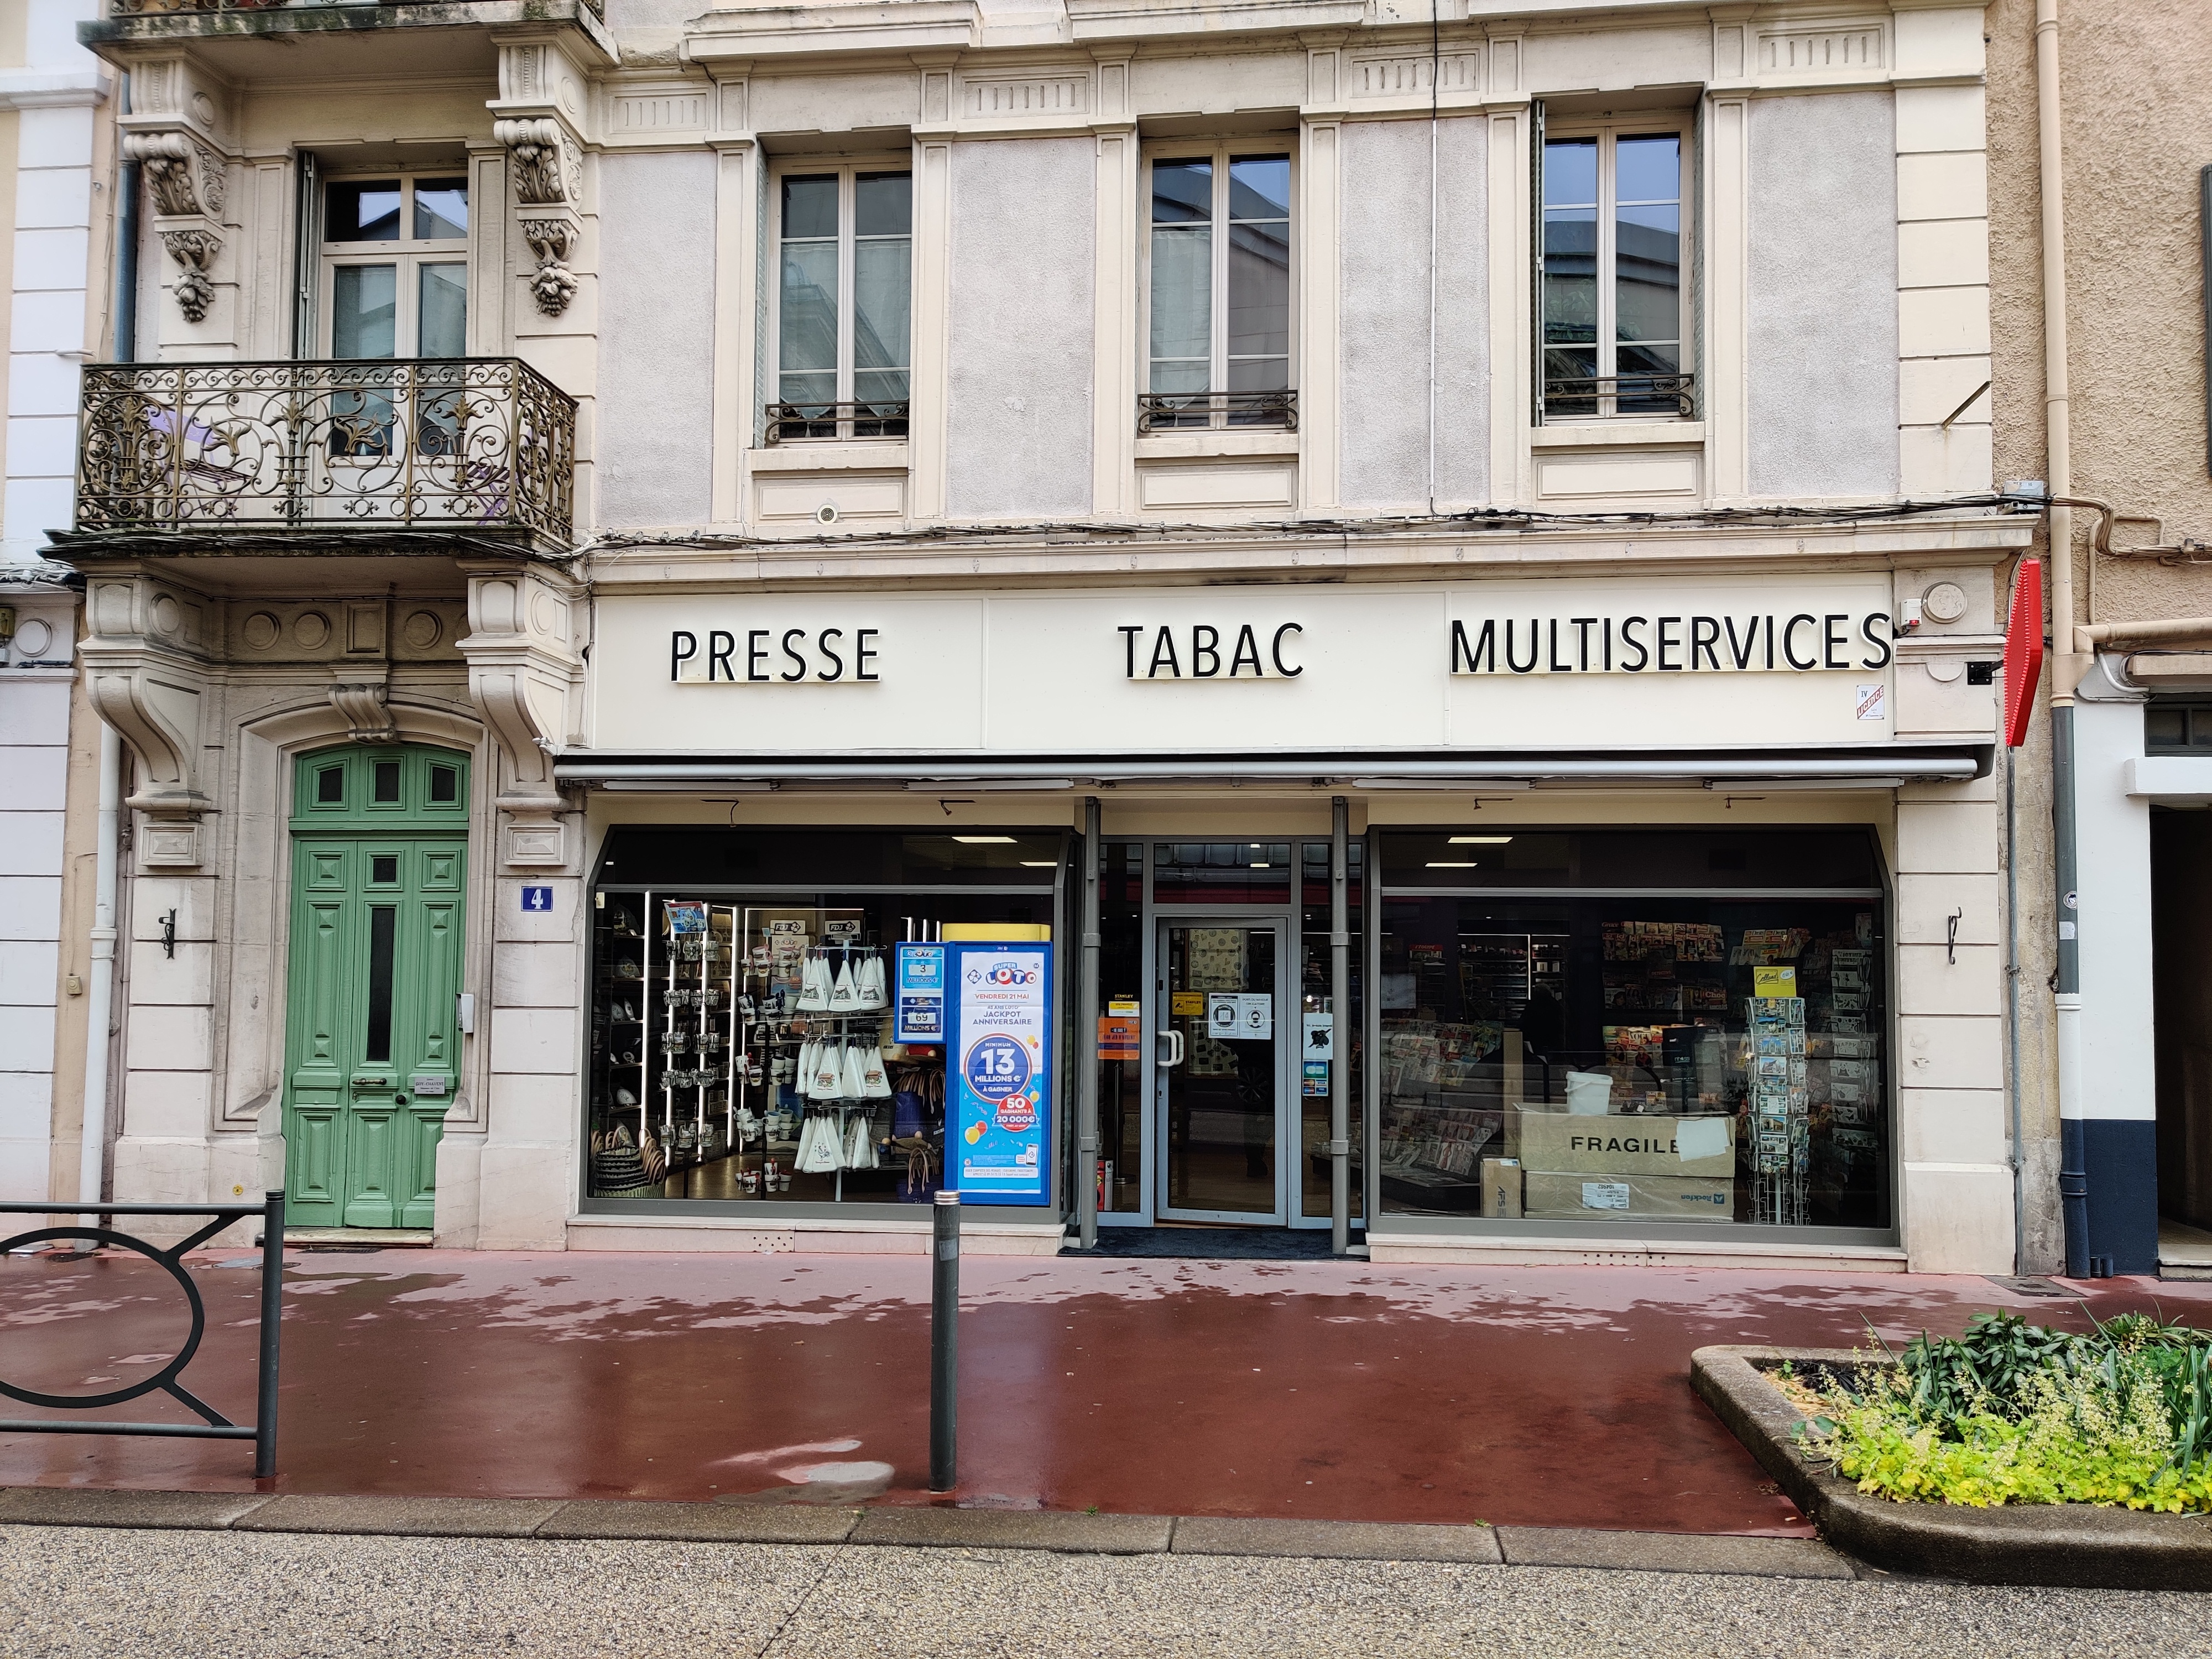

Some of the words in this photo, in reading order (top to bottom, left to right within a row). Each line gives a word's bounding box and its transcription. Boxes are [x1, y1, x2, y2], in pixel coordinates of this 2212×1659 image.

[1117, 622, 1304, 679] TABAC
[1451, 613, 1891, 674] MULTISERVICES
[671, 628, 880, 682] PRESSE
[1858, 687, 1884, 717] LICENCE
[531, 889, 544, 910] 4
[920, 964, 926, 973] 3
[994, 962, 1017, 971] SUPER
[985, 968, 1037, 985] LOTO
[916, 1013, 928, 1021] 69
[980, 1048, 1015, 1074] 13
[1006, 1098, 1026, 1109] 50
[1571, 1136, 1679, 1154] FRAGILE
